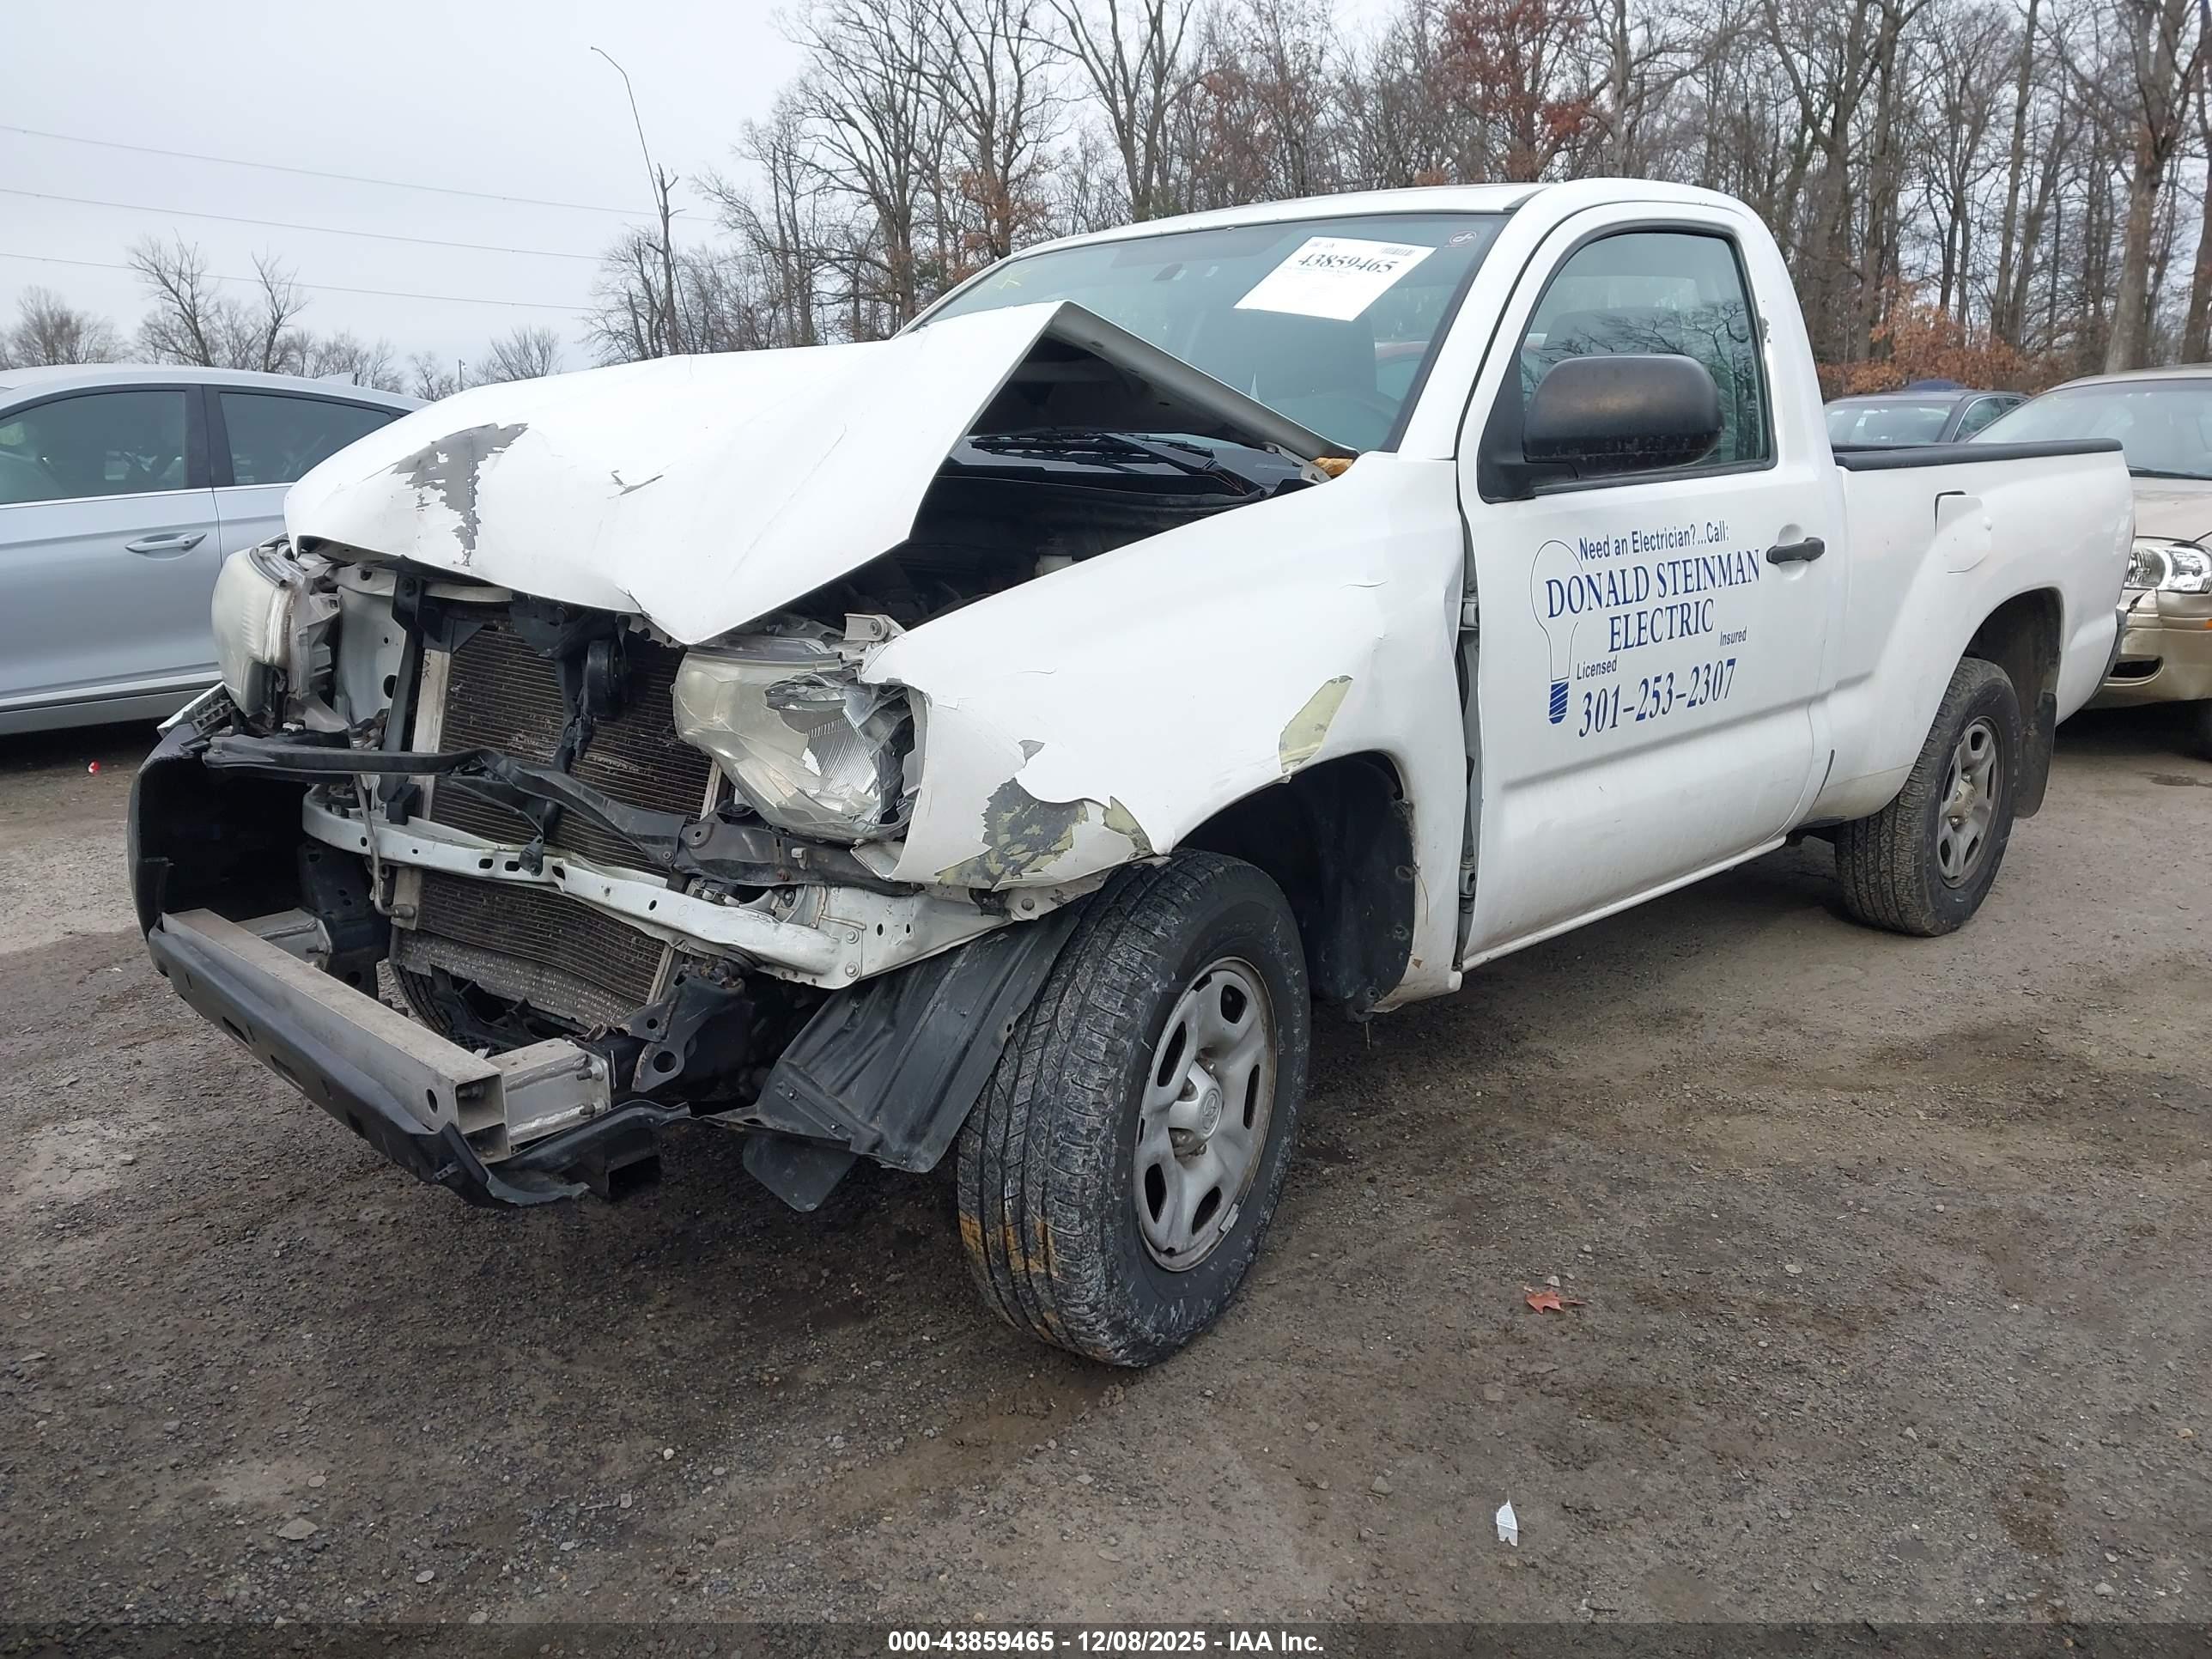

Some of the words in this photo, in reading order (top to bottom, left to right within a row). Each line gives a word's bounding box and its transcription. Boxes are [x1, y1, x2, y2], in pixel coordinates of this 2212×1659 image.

[1298, 252, 1399, 273] 43859465
[1580, 534, 1610, 561] Need
[1614, 538, 1626, 555] an
[1547, 566, 1649, 618] DONALD
[1657, 550, 1759, 598] STEINMAN
[1608, 599, 1714, 653] ELECTRIC
[1720, 626, 1747, 646] Insured
[1577, 655, 1617, 680] Licensed
[1579, 658, 1736, 737] 301-253-2307
